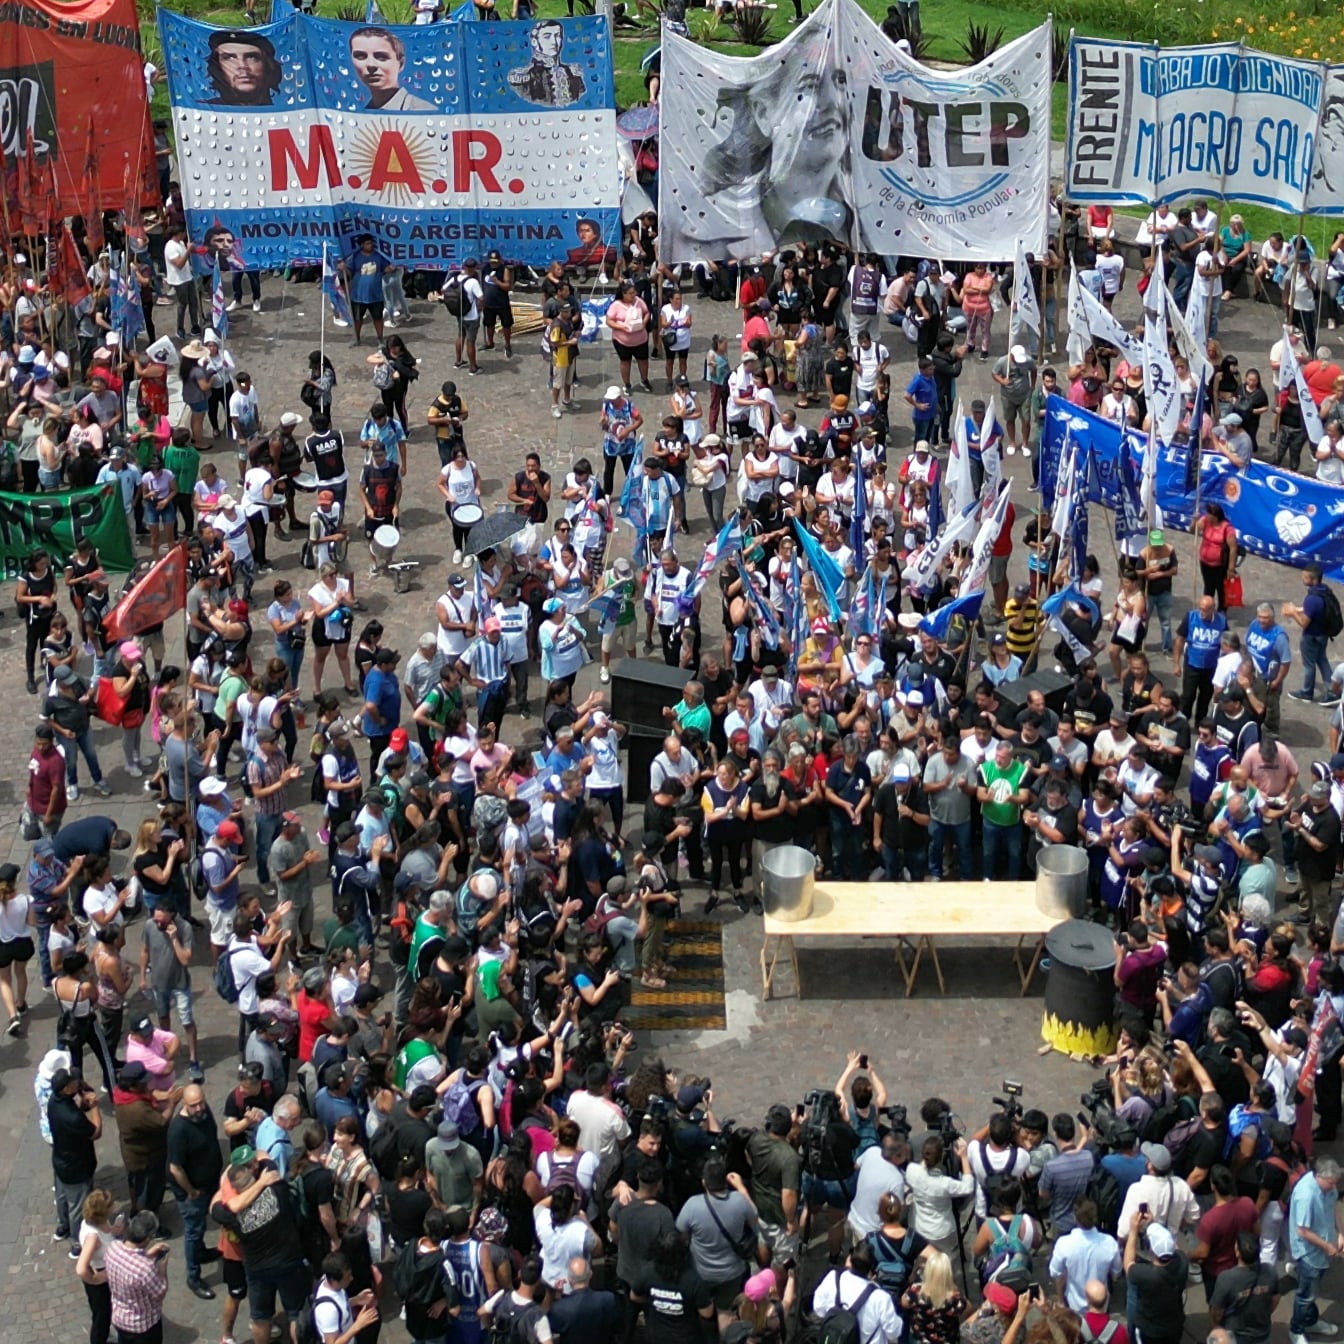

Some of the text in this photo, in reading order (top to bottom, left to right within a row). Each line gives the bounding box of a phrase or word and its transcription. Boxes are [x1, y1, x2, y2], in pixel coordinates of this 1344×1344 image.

[57, 17, 90, 41] EN
[1224, 55, 1238, 88] Y
[1238, 56, 1321, 112] DIGNIDAD
[860, 85, 1031, 168] UTEP
[1072, 48, 1119, 187] FRENTE
[268, 124, 525, 194] M.A.R.
[1253, 117, 1313, 193] SALA
[879, 185, 894, 202] de
[894, 192, 906, 211] la
[968, 185, 1016, 217] Popular
[241, 217, 564, 242] MOVIMIENTO ARGENTINA
[316, 439, 337, 451] MAR
[1192, 626, 1220, 644] MAP
[1248, 631, 1270, 650] MAP
[650, 1287, 683, 1301] PRENSA
